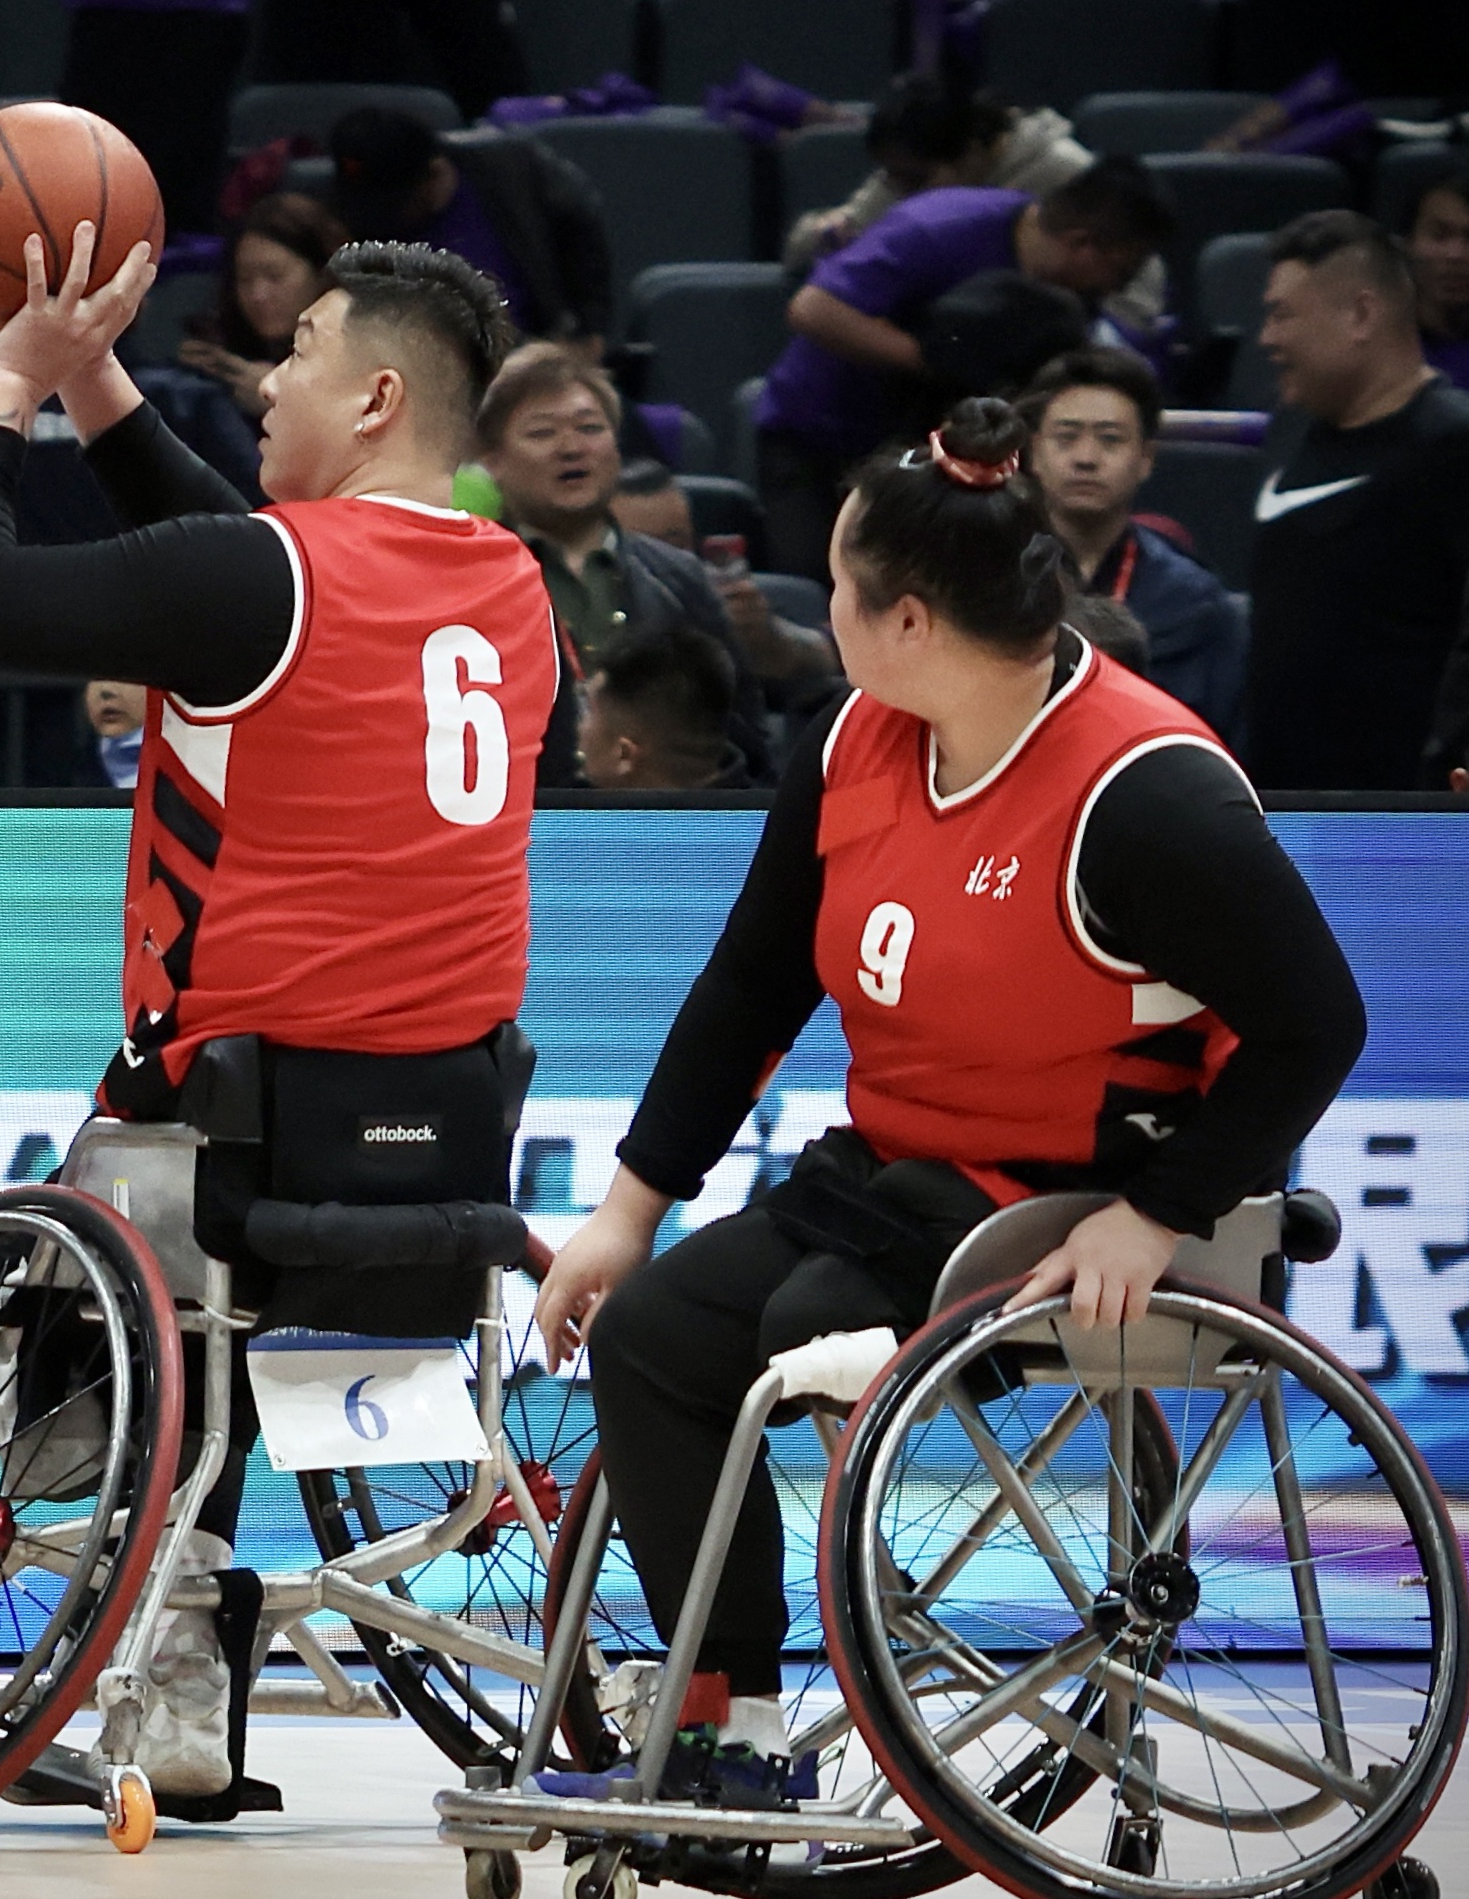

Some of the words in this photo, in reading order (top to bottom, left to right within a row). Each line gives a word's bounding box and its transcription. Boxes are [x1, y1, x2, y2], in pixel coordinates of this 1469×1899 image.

[421, 623, 510, 826] 6
[964, 855, 1021, 901] 北京
[857, 901, 916, 1007] 9
[363, 1124, 437, 1142] ottobock.
[344, 1374, 389, 1441] 6
